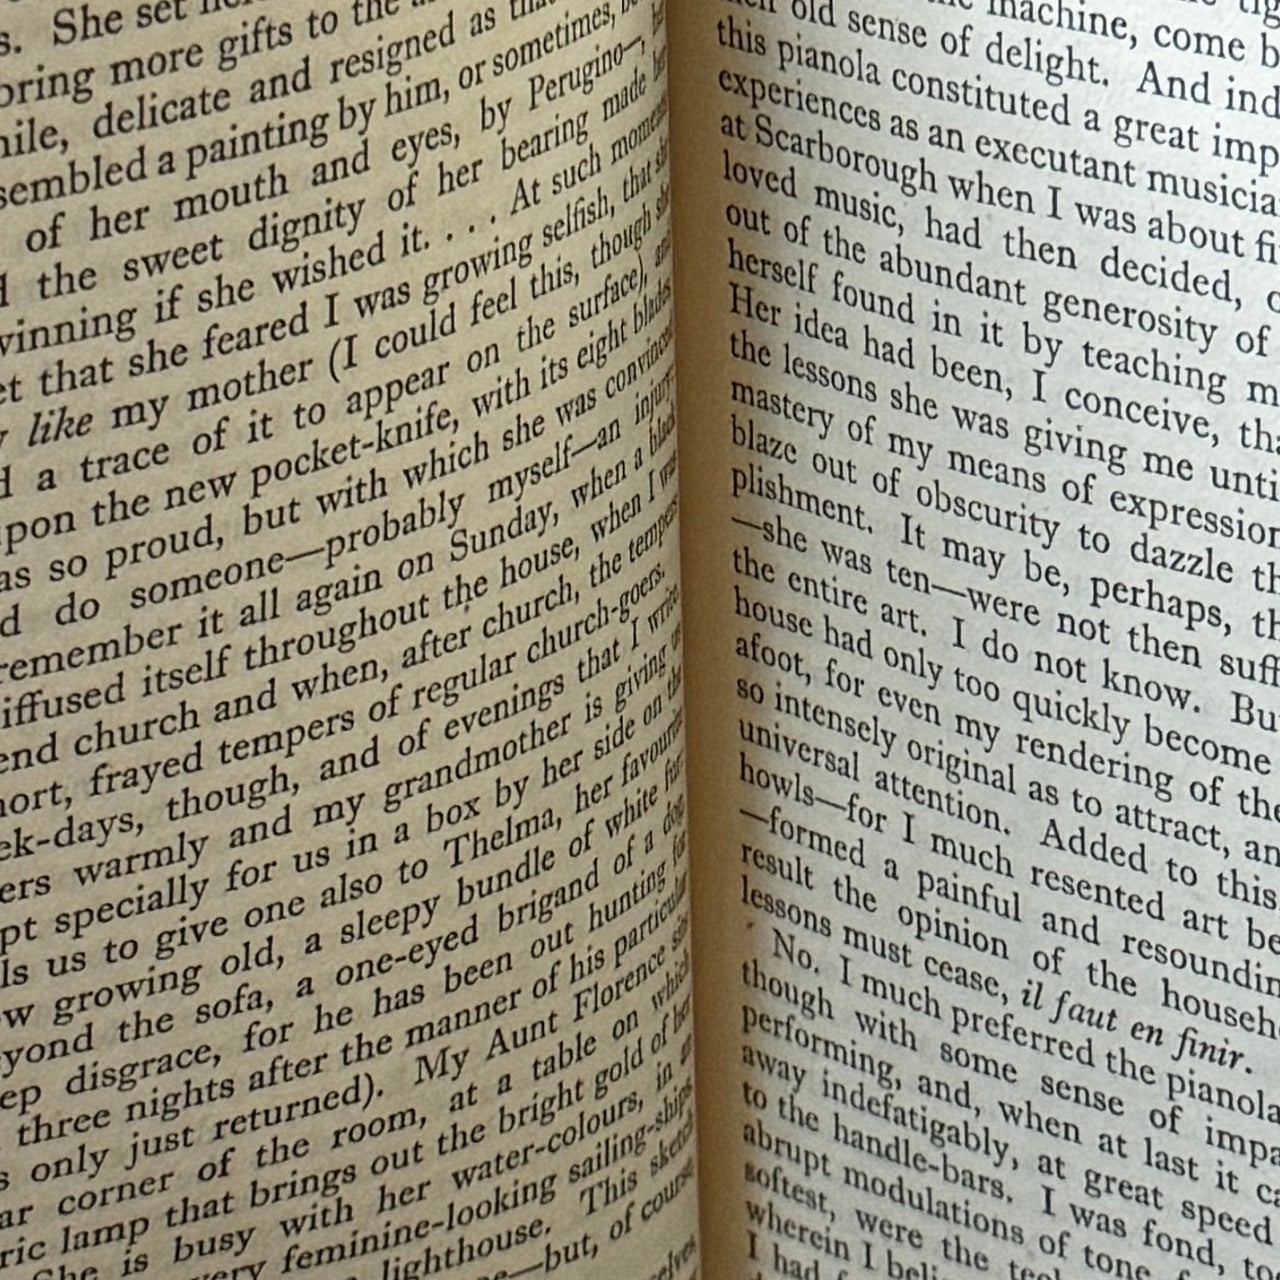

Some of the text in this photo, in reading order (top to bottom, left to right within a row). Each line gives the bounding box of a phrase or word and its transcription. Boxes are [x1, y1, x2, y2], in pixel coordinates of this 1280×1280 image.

[36, 261, 98, 301] the
[123, 233, 224, 282] sweet
[247, 196, 367, 254] dignity
[387, 169, 420, 212] of
[437, 158, 484, 197] her
[500, 109, 589, 171] bearing
[601, 65, 647, 123] made
[716, 14, 767, 57] this
[776, 31, 882, 86] pianola
[891, 68, 1071, 127] constituted
[1083, 108, 1102, 133] a
[1113, 114, 1200, 153] great
[91, 489, 151, 527] the
[163, 470, 238, 511] new
[250, 399, 459, 500] pocket-knife,
[471, 366, 532, 419] with
[540, 354, 569, 391] its
[576, 317, 628, 370] eight
[731, 461, 873, 535] plishment.
[900, 511, 926, 551] It
[941, 536, 1007, 581] may
[1023, 548, 1070, 598] be,
[1089, 576, 1232, 638] perhaps,
[88, 739, 205, 798] frayed
[217, 709, 355, 766] tempers
[367, 682, 404, 723] of
[411, 650, 518, 711] regular
[526, 562, 666, 664] church-goers.
[741, 843, 815, 891] result
[832, 874, 878, 914] the
[897, 905, 1010, 961] opinion
[1032, 945, 1066, 976] of
[1086, 958, 1137, 998] the
[30, 1143, 111, 1183] only
[123, 1125, 195, 1172] just
[211, 1072, 384, 1143] returned).
[413, 1045, 470, 1086] My
[484, 1009, 559, 1062] Aunt
[572, 944, 666, 1024] Florence
[741, 1044, 808, 1095] away
[822, 1067, 1019, 1171] indefatigably,
[1037, 1154, 1067, 1181] at
[1084, 1168, 1164, 1212] great
[1180, 1199, 1274, 1247] speed
